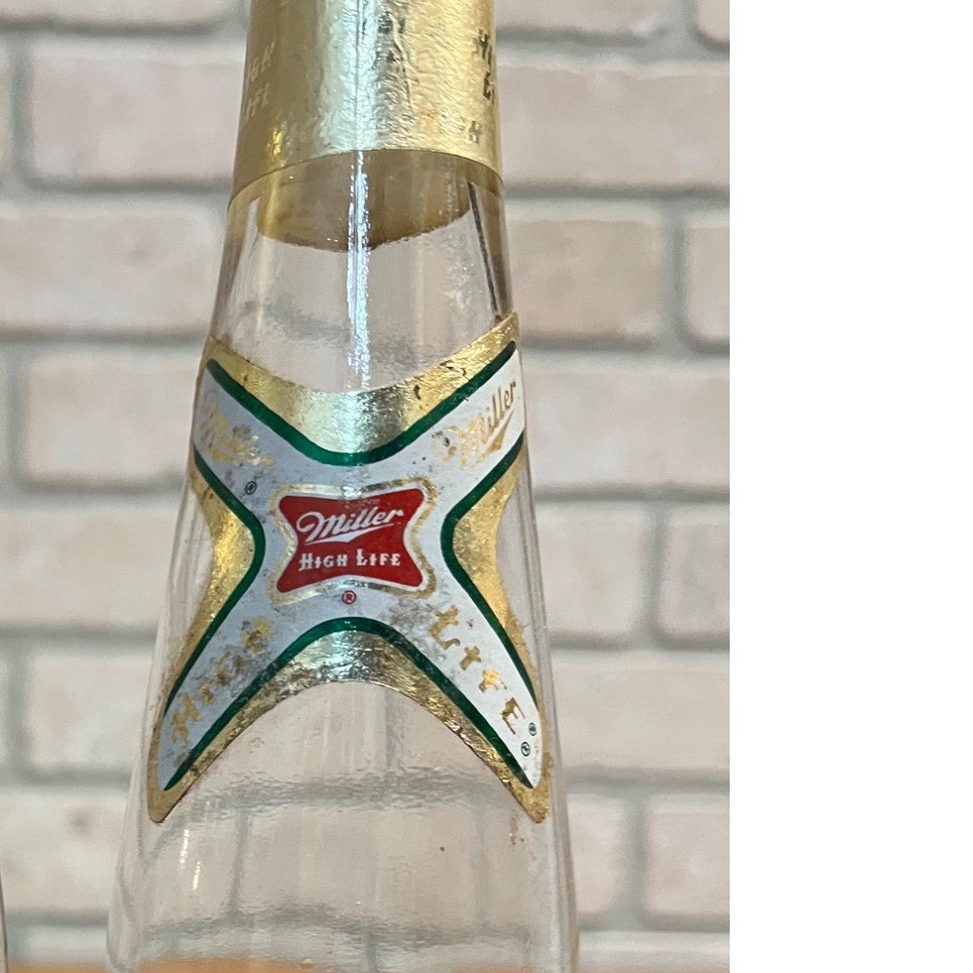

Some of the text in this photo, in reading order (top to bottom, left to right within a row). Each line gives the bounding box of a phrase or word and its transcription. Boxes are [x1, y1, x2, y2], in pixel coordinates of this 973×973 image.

[296, 507, 404, 545] Miller
[299, 548, 401, 571] HIGH LIFE
[430, 605, 524, 735] LIFE
